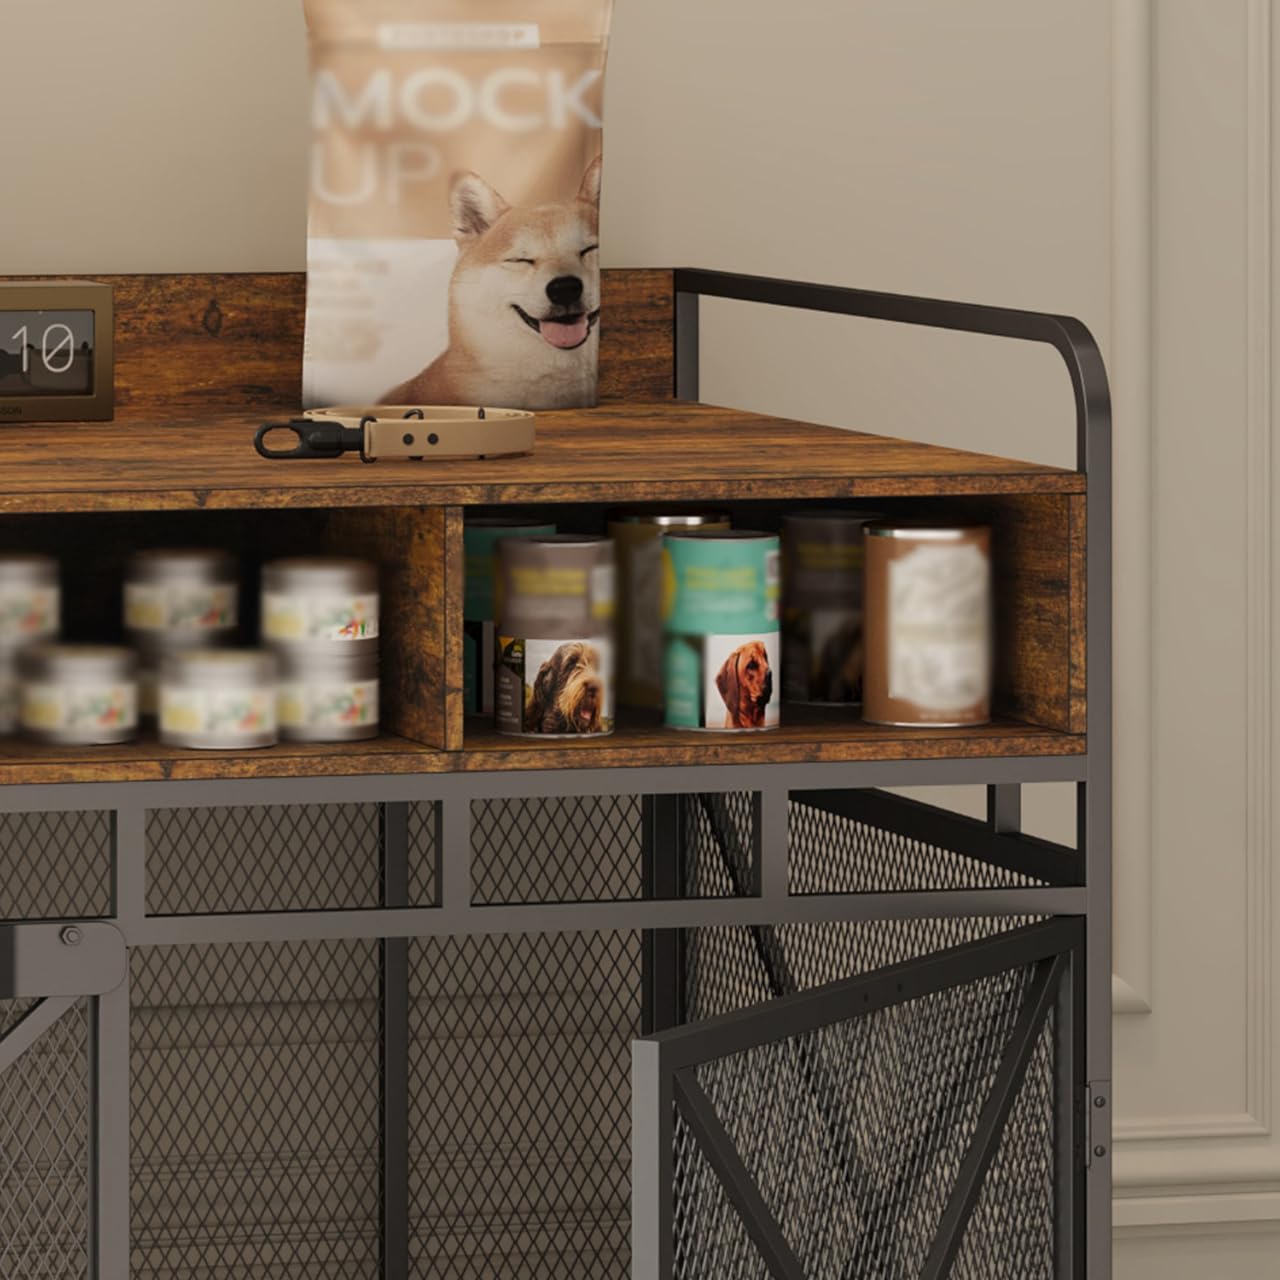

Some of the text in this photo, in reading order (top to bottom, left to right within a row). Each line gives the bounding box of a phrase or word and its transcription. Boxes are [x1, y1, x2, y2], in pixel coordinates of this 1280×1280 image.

[312, 66, 604, 132] MOCK
[311, 141, 445, 207] UP
[11, 323, 74, 373] 10
